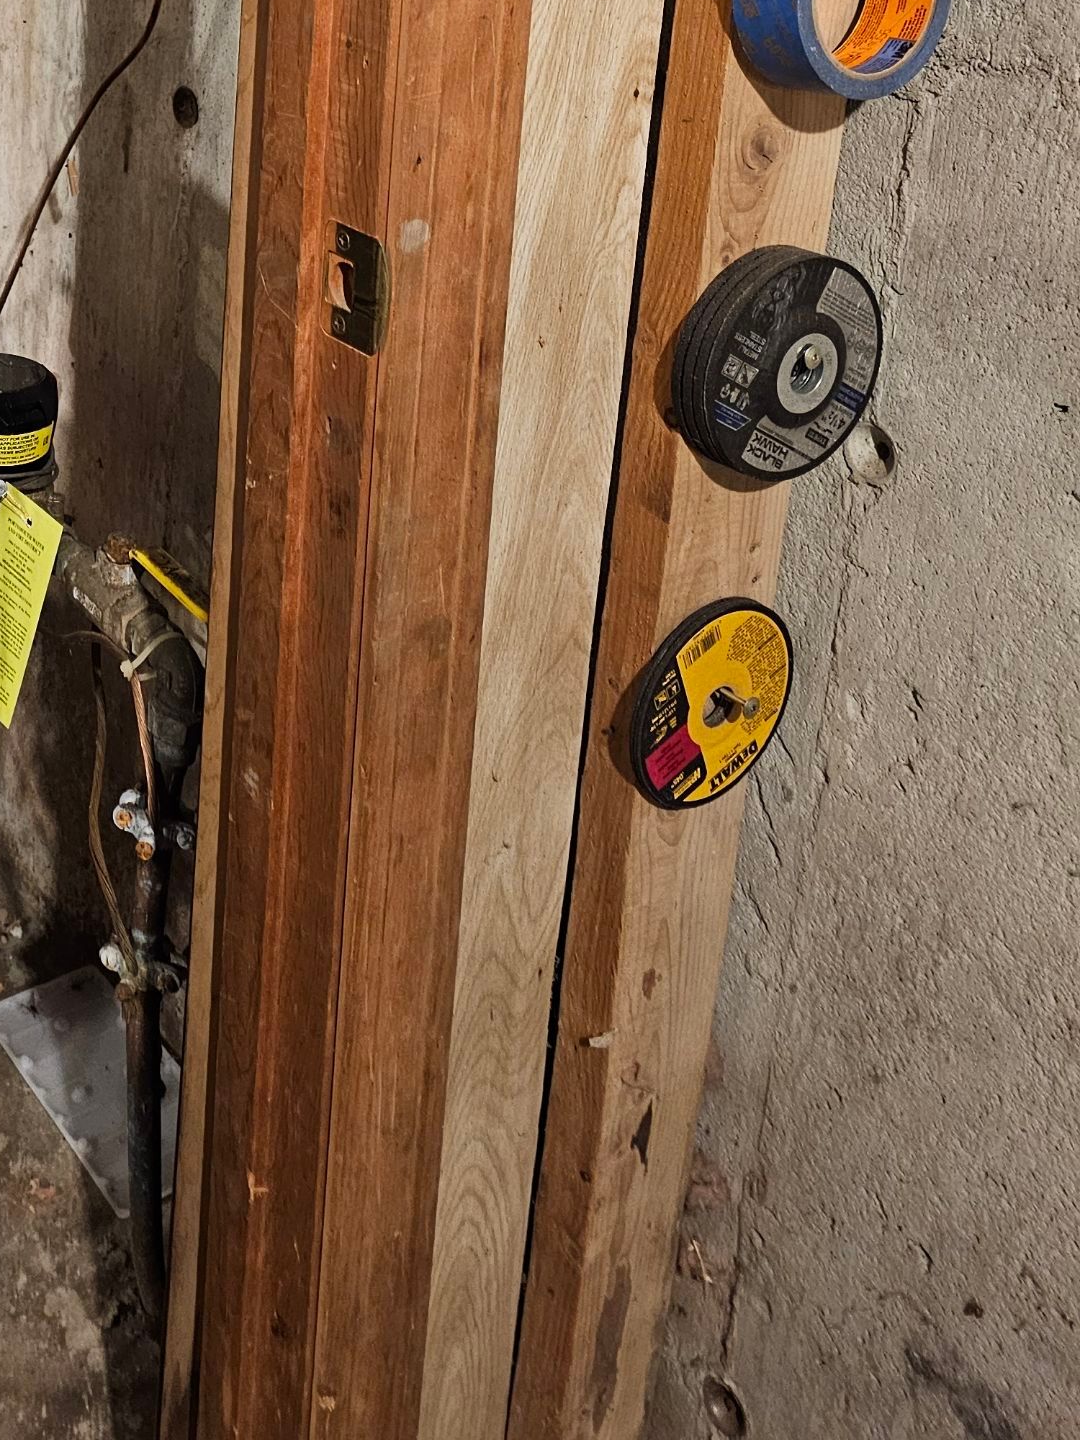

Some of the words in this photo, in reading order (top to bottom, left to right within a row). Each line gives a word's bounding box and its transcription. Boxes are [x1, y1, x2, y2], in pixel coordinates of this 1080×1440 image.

[734, 332, 763, 353] STAINLESS
[747, 444, 784, 470] BLACK
[751, 433, 789, 459] HAWK
[710, 739, 758, 793] DEWALT
